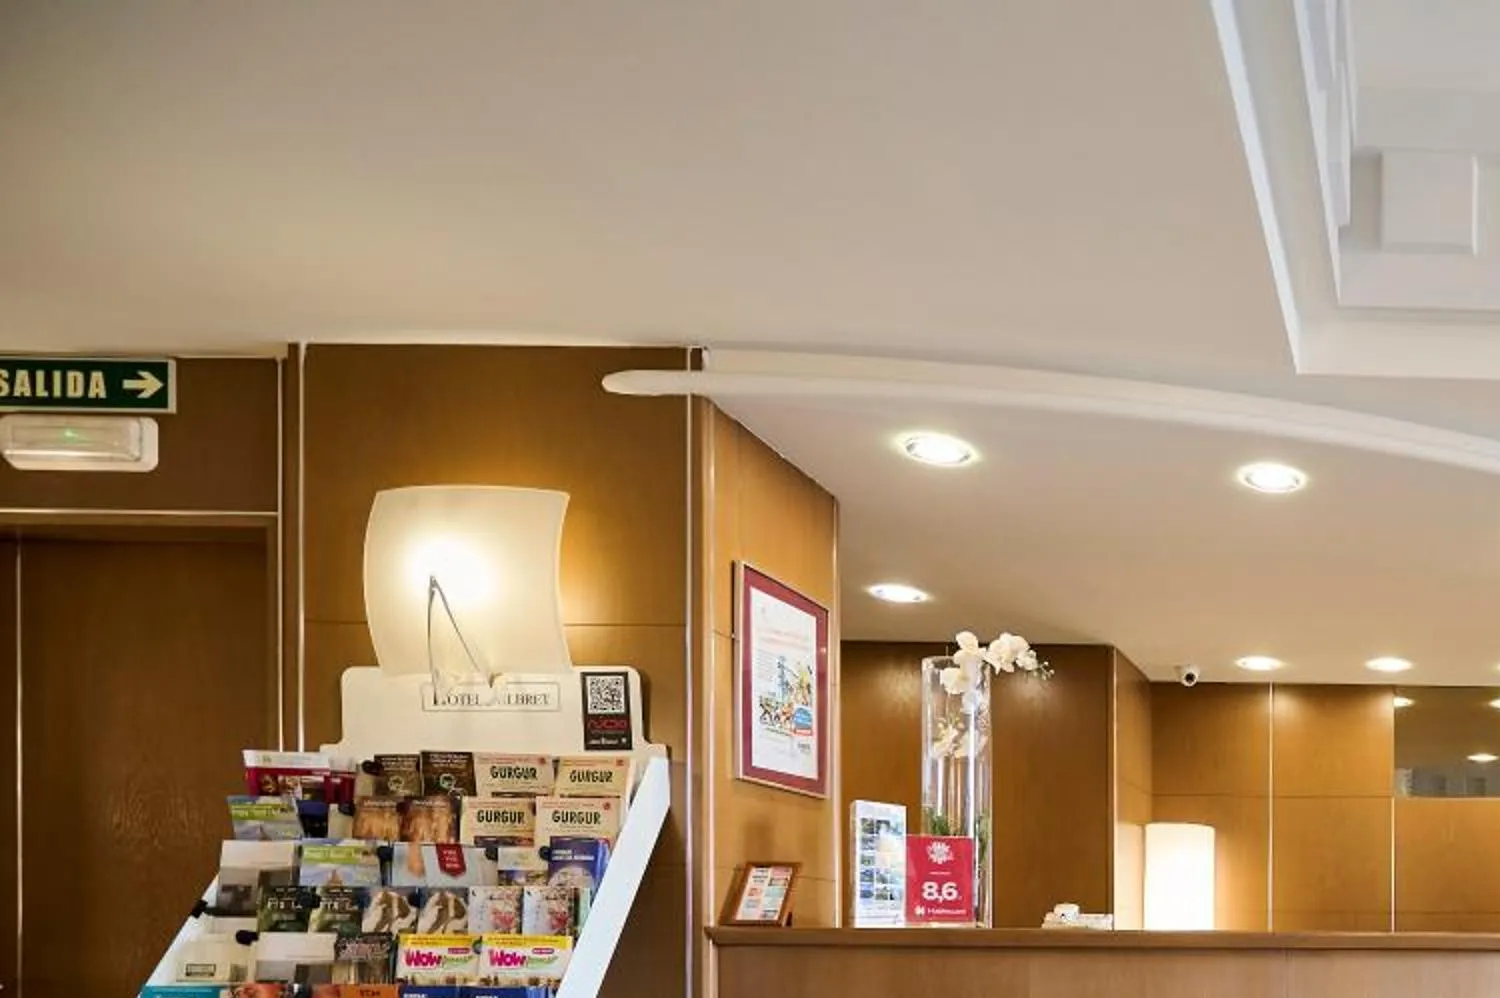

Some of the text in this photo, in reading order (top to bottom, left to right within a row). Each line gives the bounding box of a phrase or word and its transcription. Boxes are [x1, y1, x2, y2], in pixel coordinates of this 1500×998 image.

[0, 369, 107, 399] SALIDA
[490, 765, 538, 781] GURGUR
[569, 769, 613, 784] GURGUR
[477, 809, 525, 825] GURGUR
[551, 809, 601, 825] GURGUR
